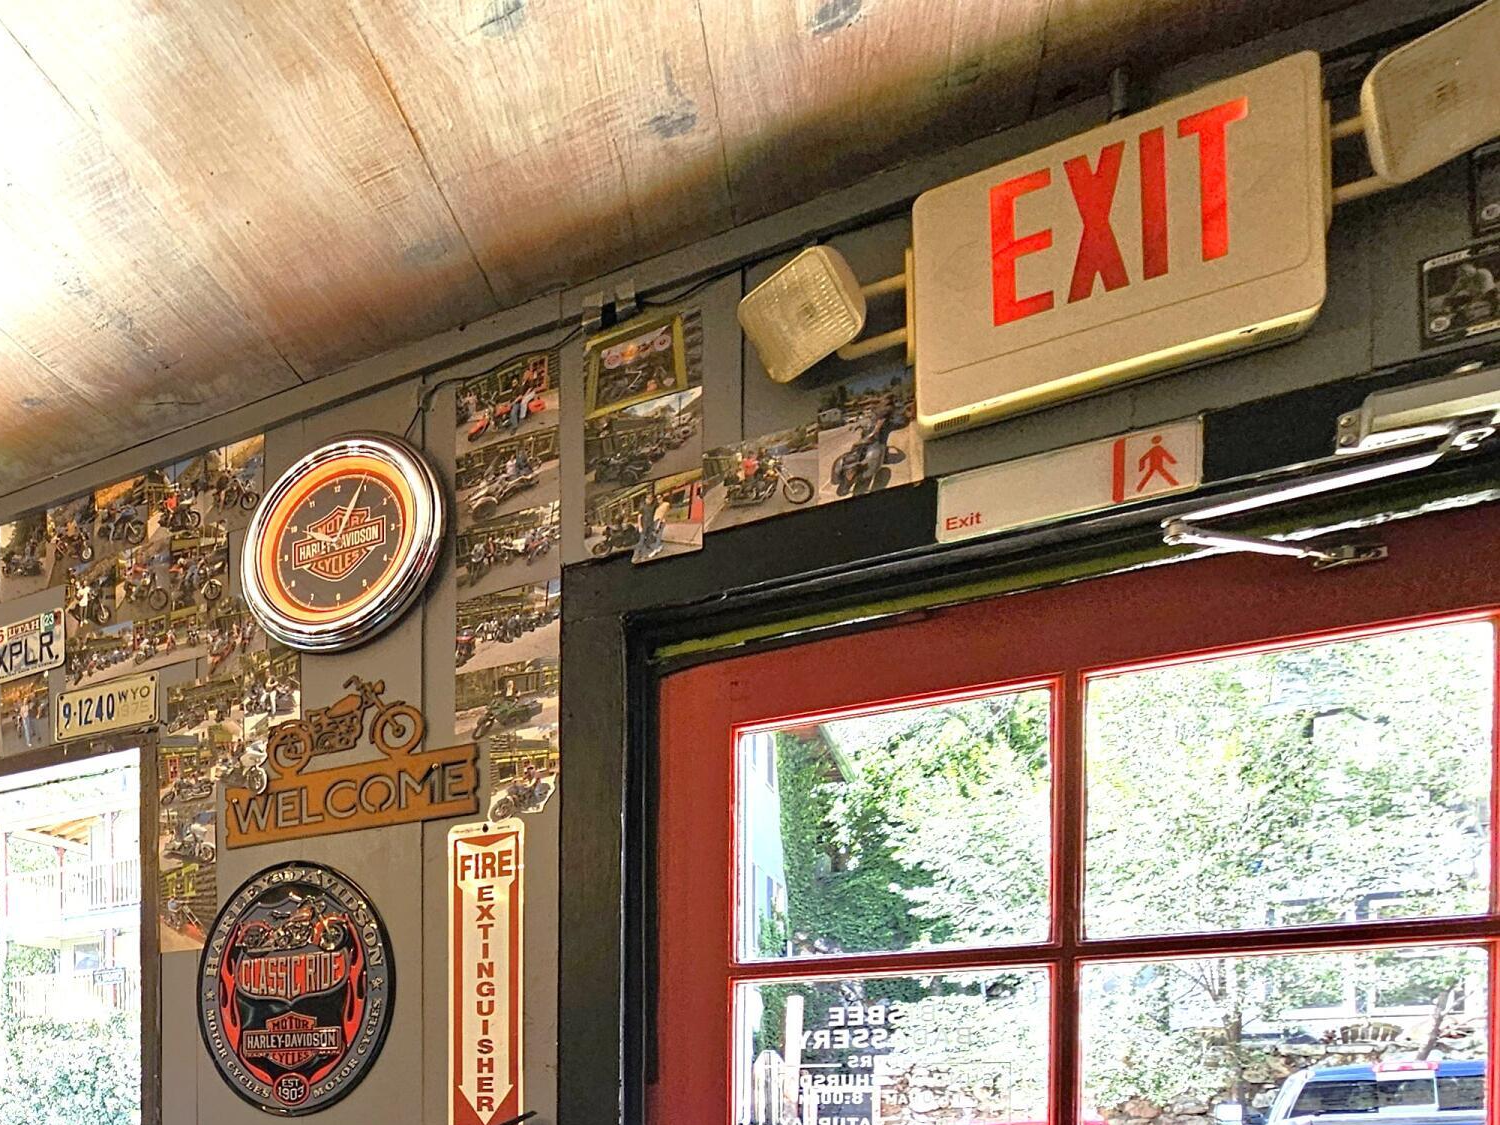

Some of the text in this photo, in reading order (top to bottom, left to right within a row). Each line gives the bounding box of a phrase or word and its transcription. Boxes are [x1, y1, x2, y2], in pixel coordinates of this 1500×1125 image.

[989, 96, 1248, 327] EXIT
[318, 512, 366, 535] MOTR
[946, 512, 982, 531] Exit
[299, 524, 379, 561] HARLEYAVIDSON
[315, 549, 360, 574] CYCLES
[7, 618, 40, 638] UTAH
[44, 612, 55, 627] 23
[117, 685, 151, 704] WYO
[116, 702, 150, 719] 1975
[235, 758, 471, 834] WELCOME
[459, 849, 513, 881] FIRE
[241, 951, 344, 1000] CLASSIC RIDE
[476, 884, 496, 1112] EXTINGUISHER
[271, 1015, 310, 1030] MOTOR
[246, 1031, 337, 1050] HARLEY-DAVIDSON
[312, 999, 383, 1099] MOTOR CYCLES
[205, 1008, 272, 1099] MOTOR CYCLES
[271, 1052, 310, 1066] CYCLES
[277, 1086, 305, 1102] 1903
[281, 1078, 300, 1088] EST
